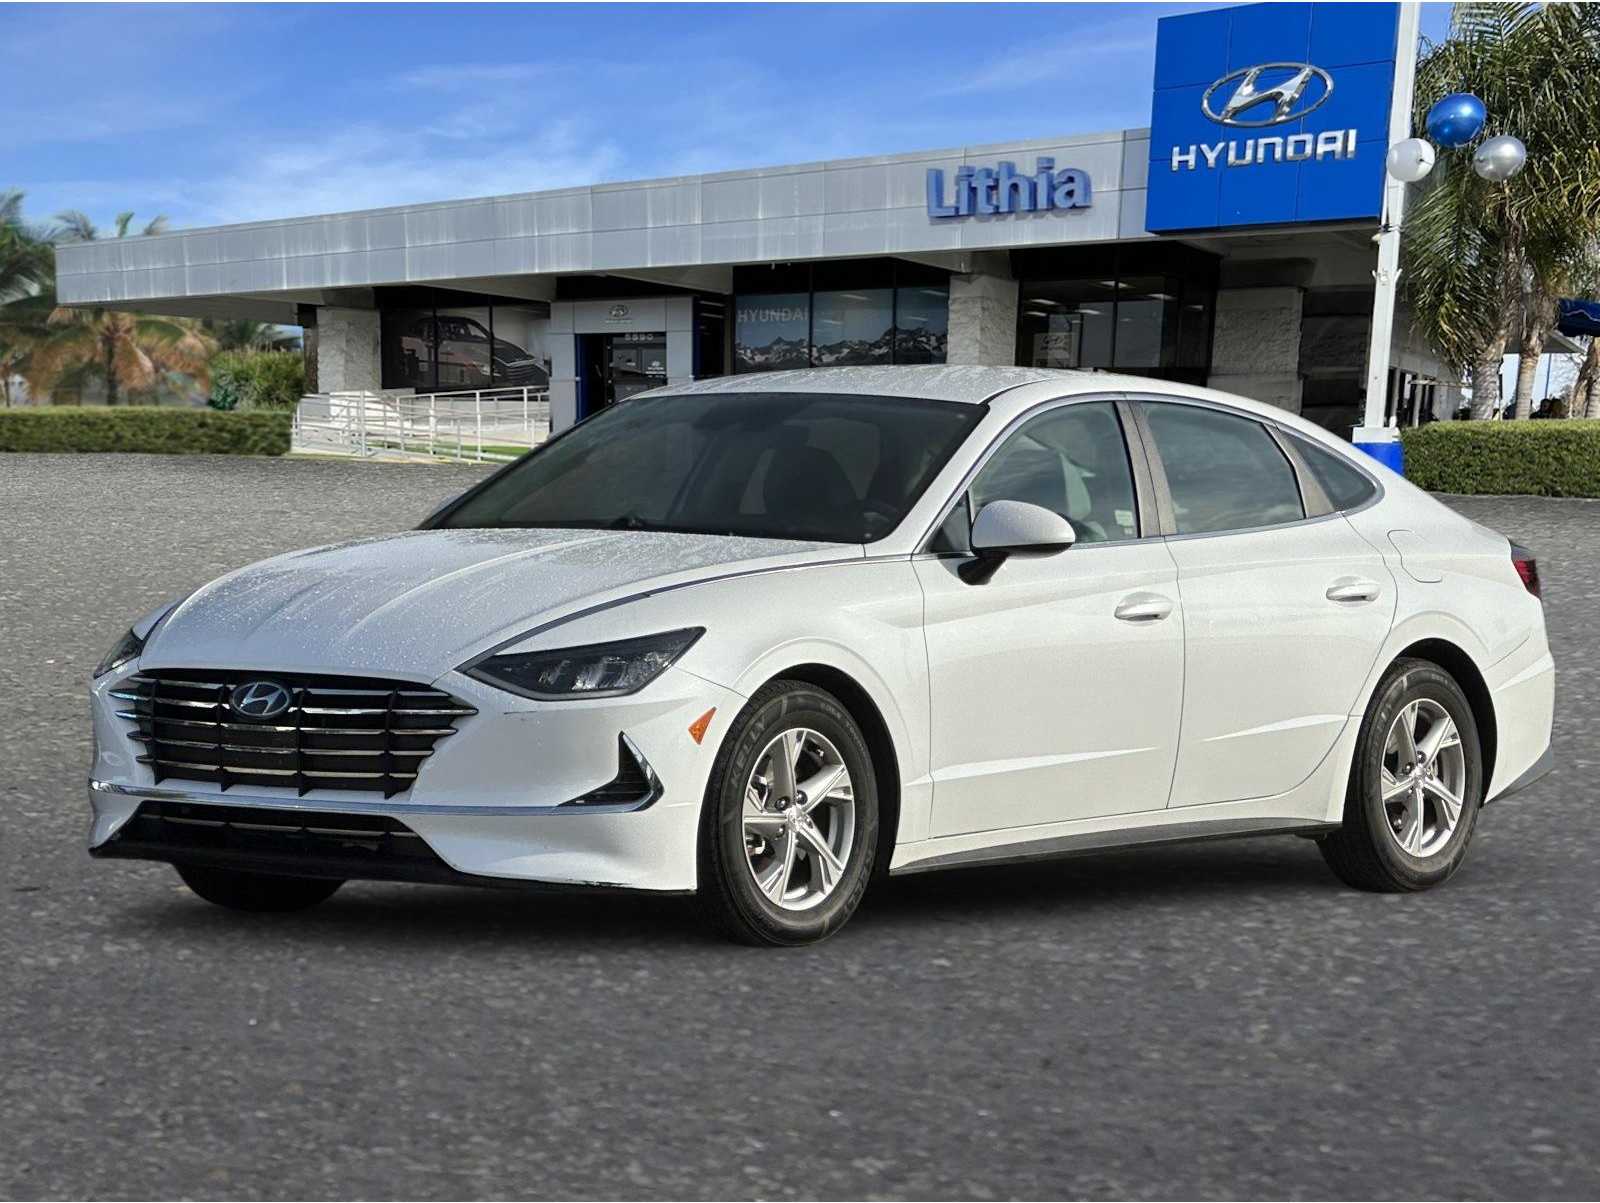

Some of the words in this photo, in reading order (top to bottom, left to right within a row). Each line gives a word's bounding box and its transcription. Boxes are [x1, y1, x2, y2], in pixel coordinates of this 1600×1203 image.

[1171, 129, 1357, 171] HYUNDAI
[927, 157, 1092, 218] Lithia
[738, 307, 809, 322] HYUNDAI
